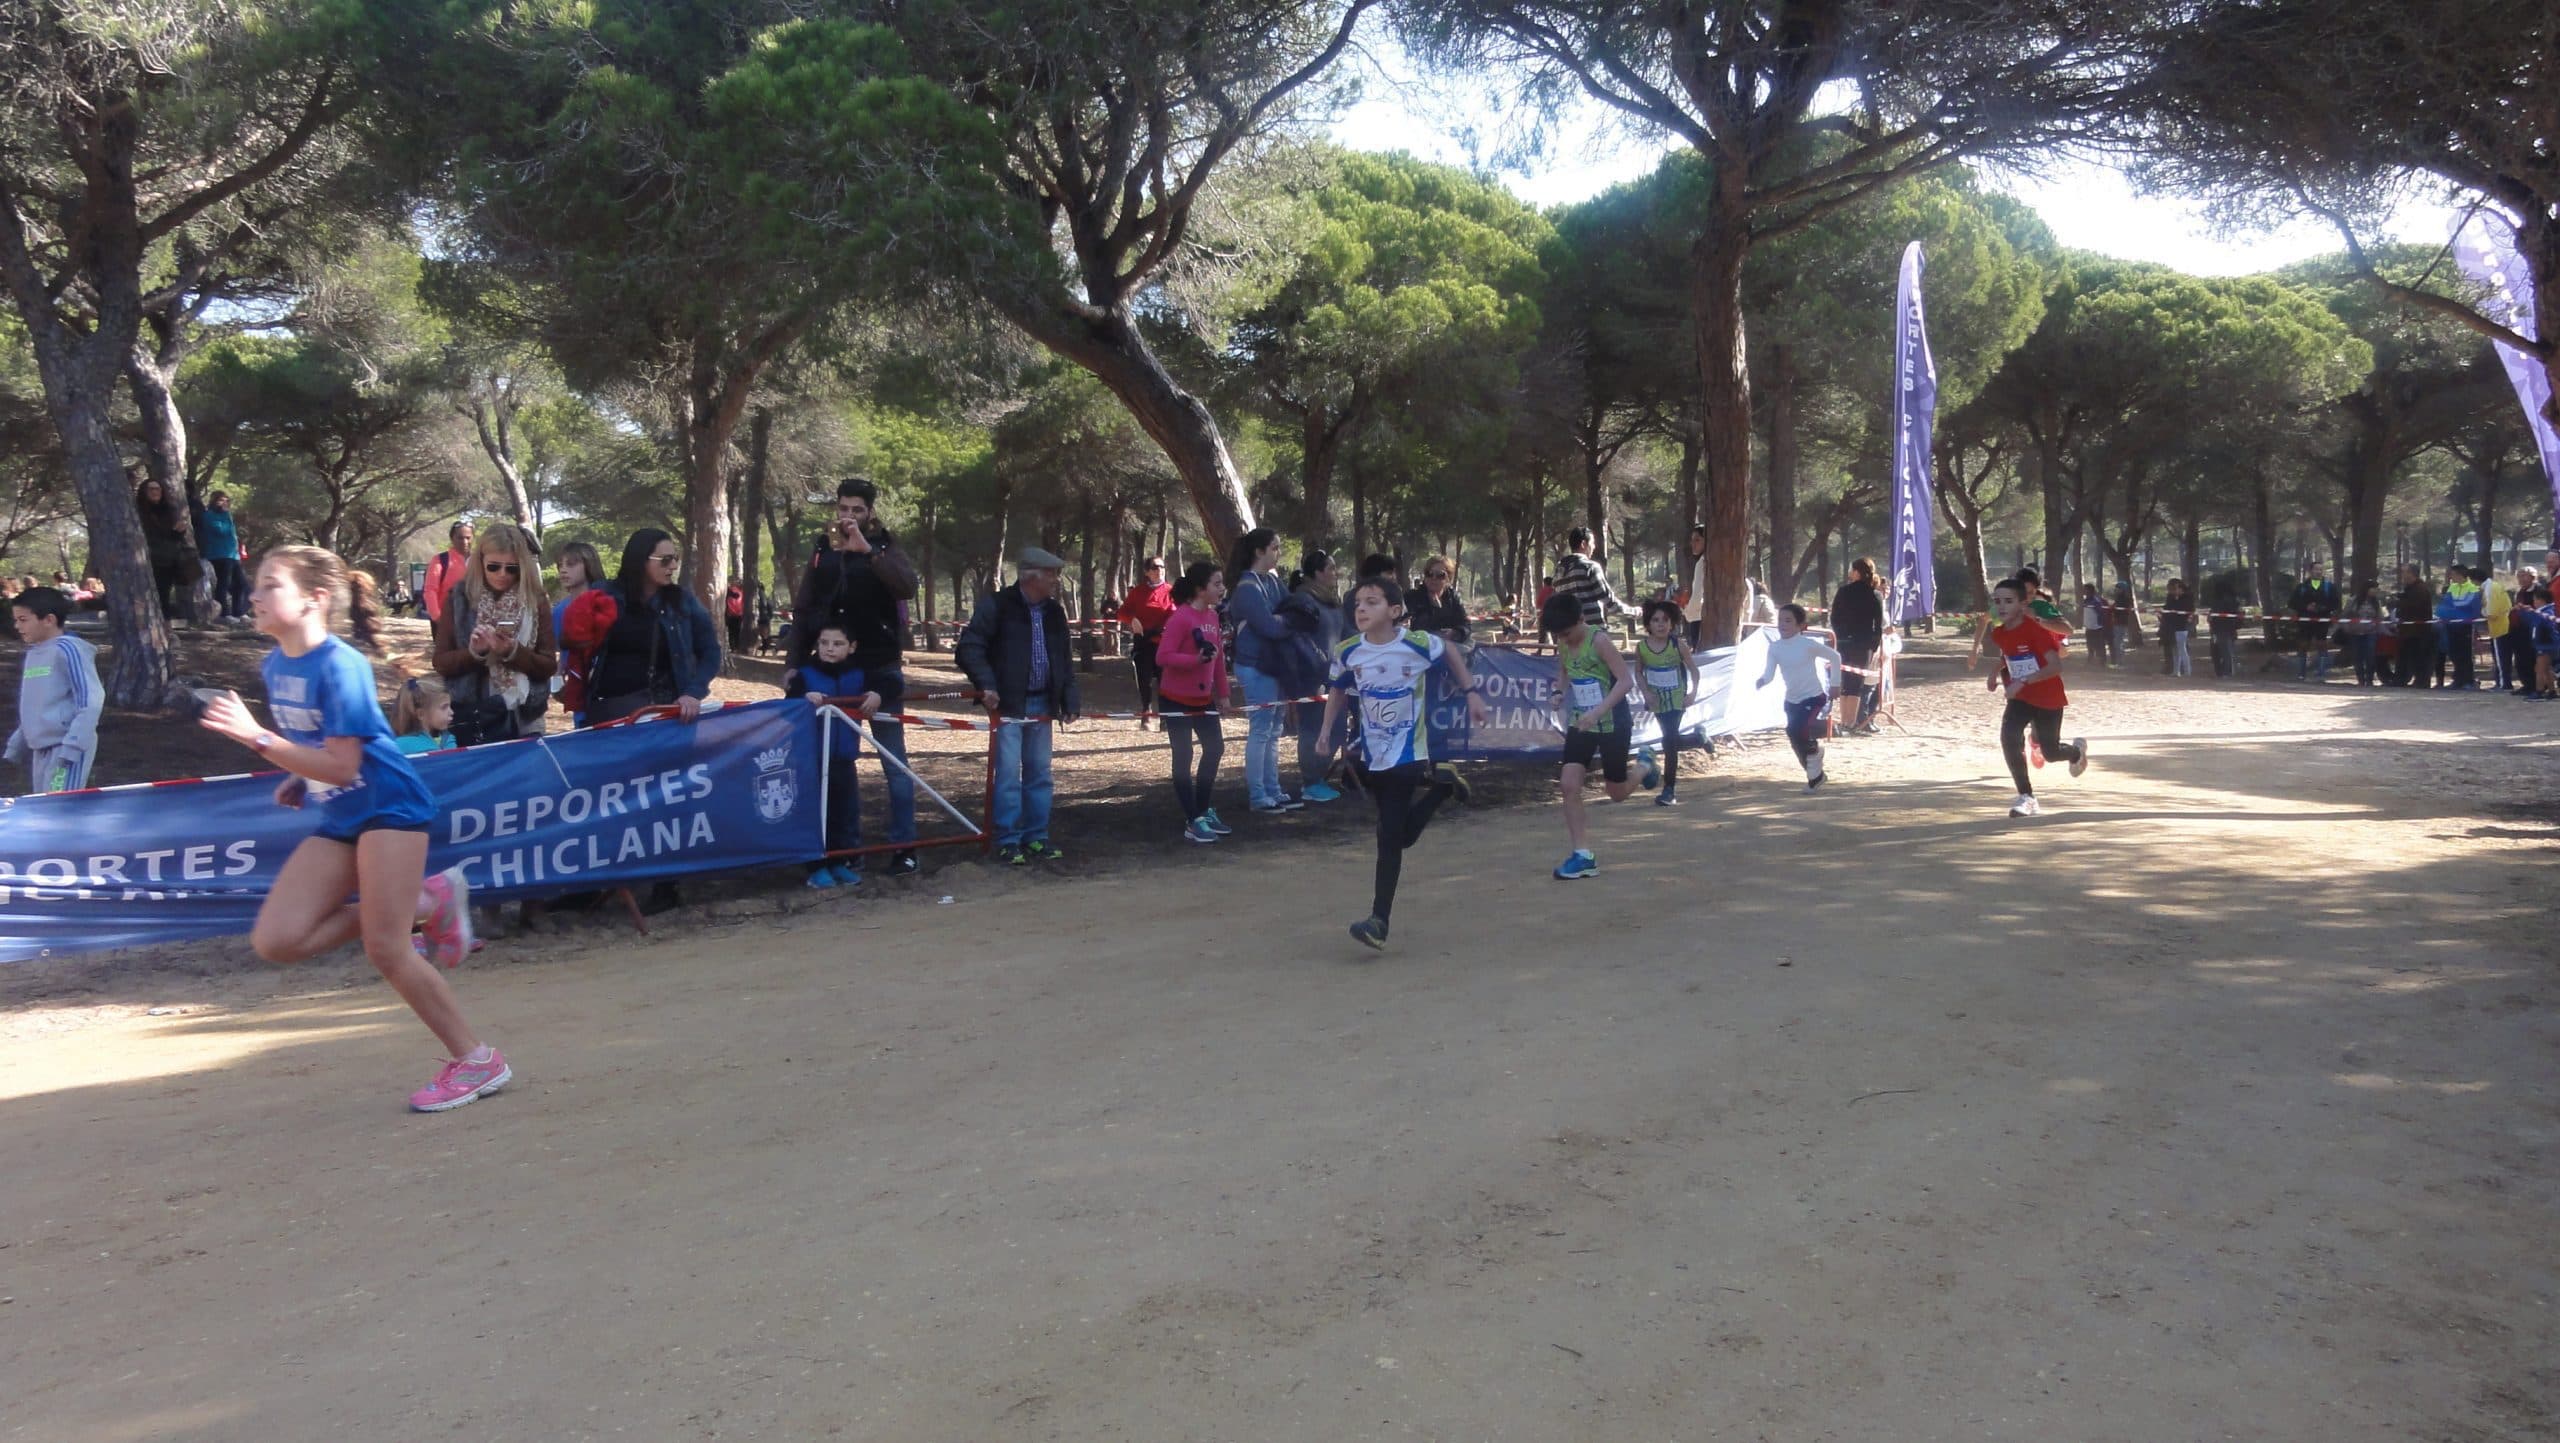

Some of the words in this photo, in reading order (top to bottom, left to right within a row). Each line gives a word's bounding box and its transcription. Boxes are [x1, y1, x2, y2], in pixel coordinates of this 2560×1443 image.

[1371, 700, 1398, 723] 16
[449, 763, 714, 845] DEPORTES
[463, 811, 716, 889] CHICLANA
